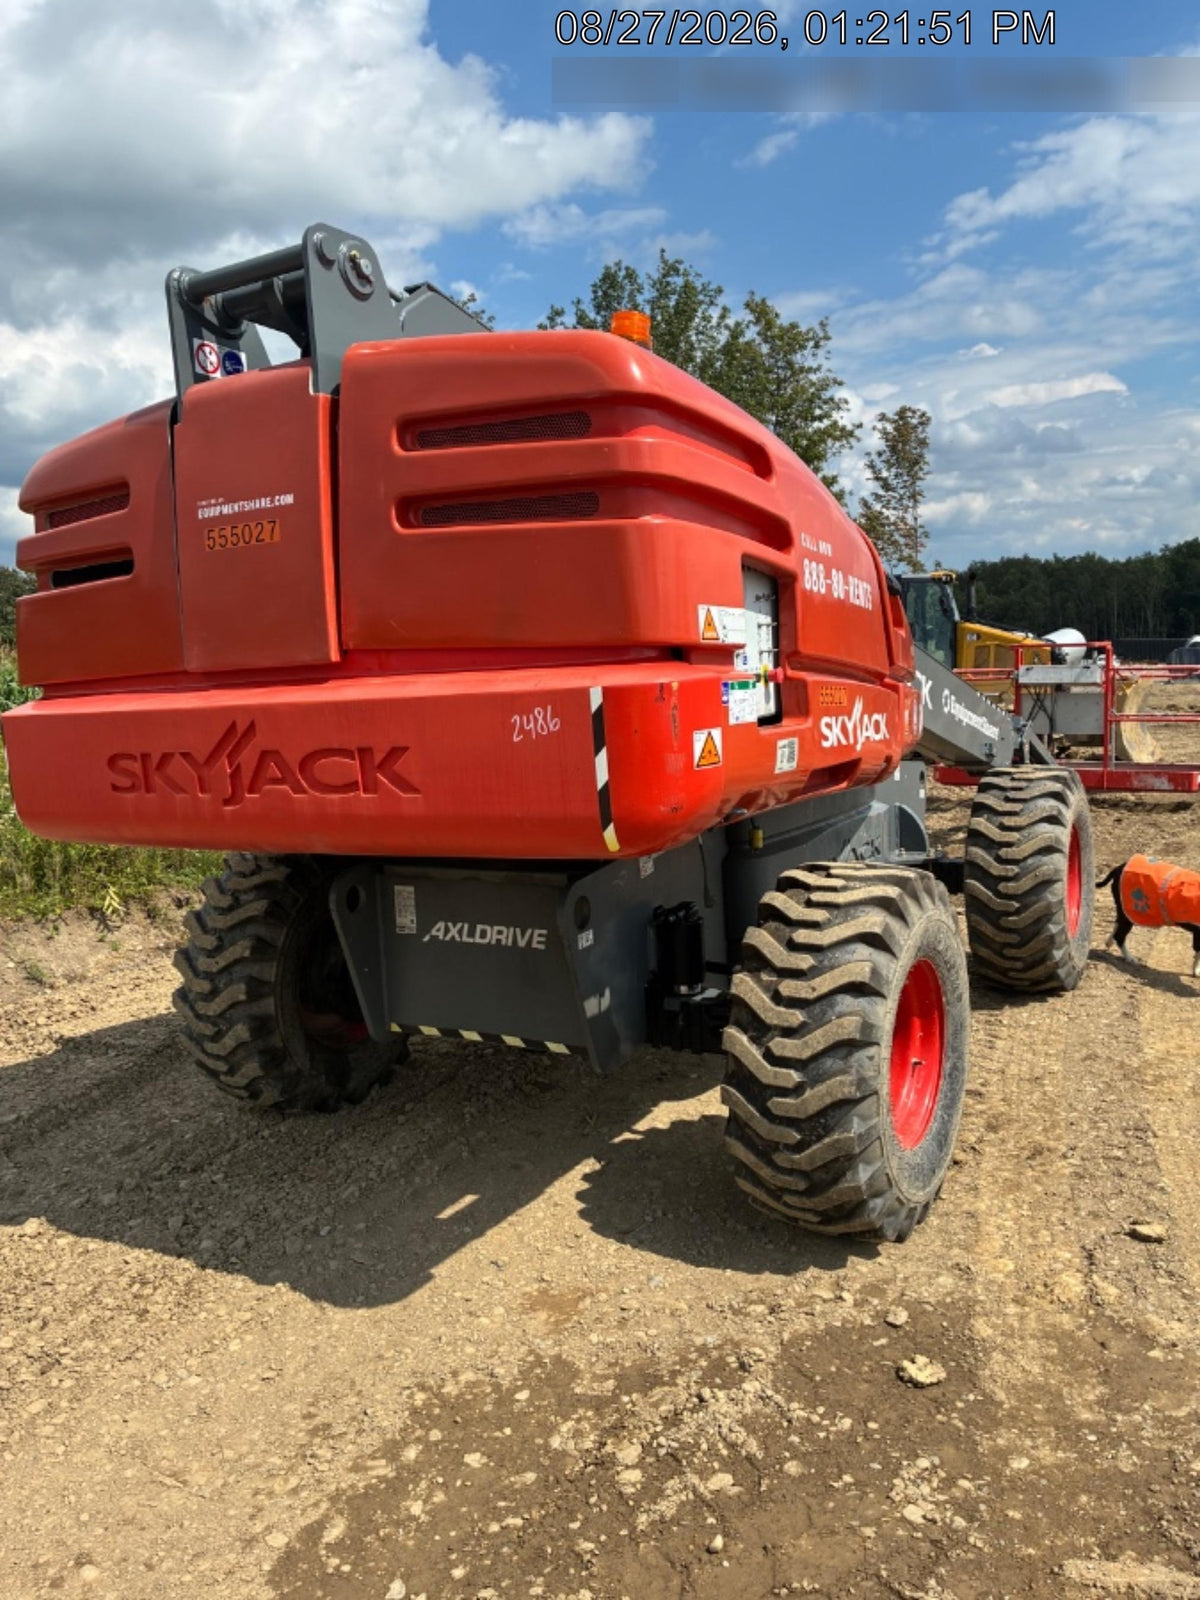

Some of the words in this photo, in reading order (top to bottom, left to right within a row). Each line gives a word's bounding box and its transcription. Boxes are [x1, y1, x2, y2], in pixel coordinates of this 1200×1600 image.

[206, 520, 277, 551] 555027
[510, 703, 561, 743] 2486
[819, 695, 890, 753] SKYJACK
[106, 718, 423, 810] SKYJACK
[422, 919, 549, 951] AXLDRIVE
